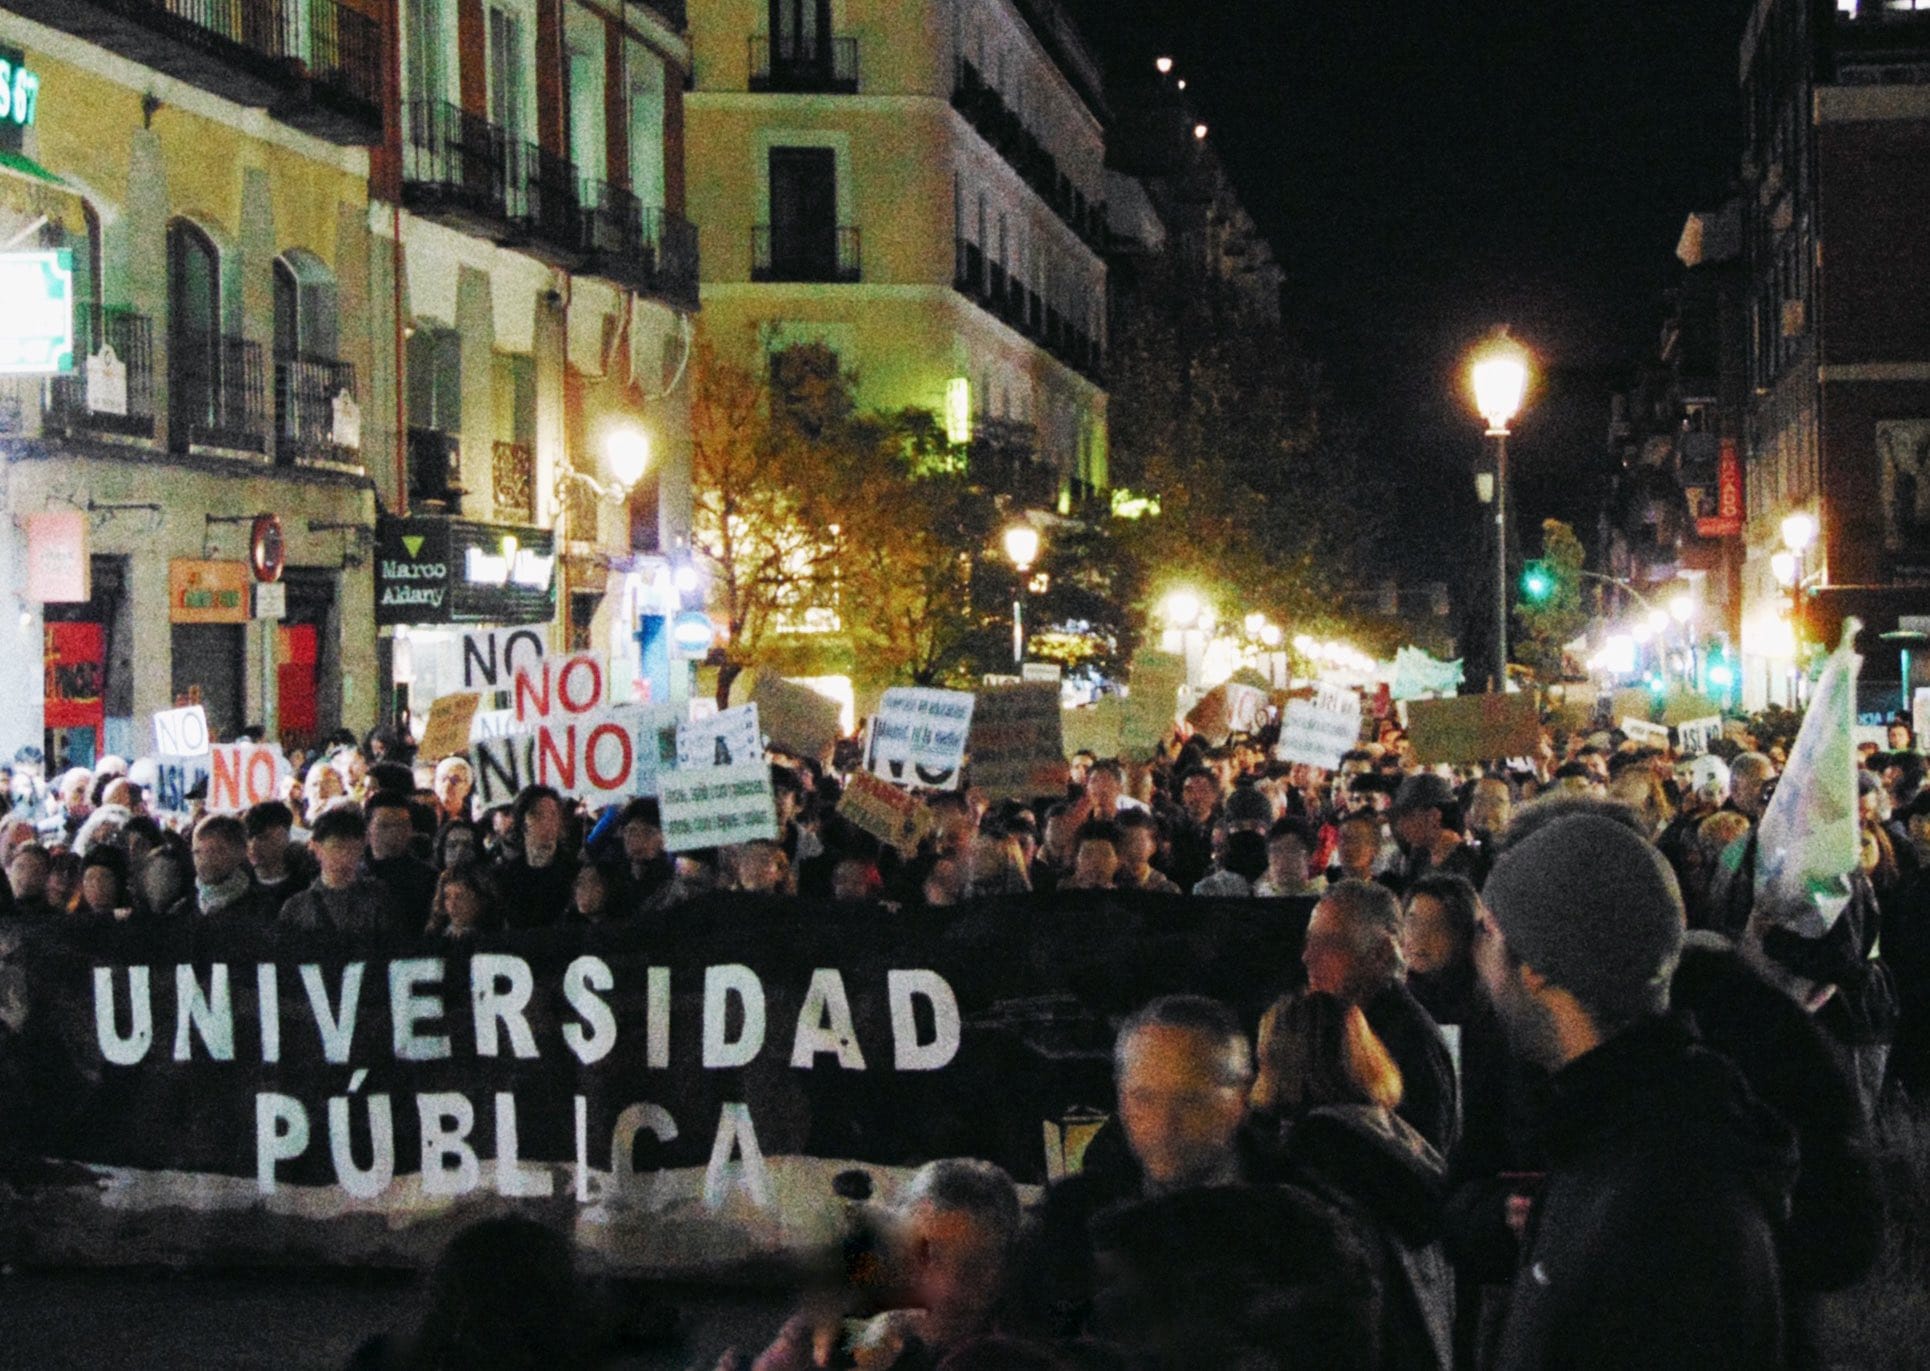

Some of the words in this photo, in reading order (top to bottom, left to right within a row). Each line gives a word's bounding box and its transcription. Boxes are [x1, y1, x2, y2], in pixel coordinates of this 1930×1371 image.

[382, 560, 447, 579] Marco
[382, 585, 446, 608] Aldany
[463, 630, 545, 688] NO
[515, 656, 602, 722] NO
[159, 711, 204, 753] NO
[538, 722, 633, 791] NO
[212, 748, 276, 809] NO
[474, 733, 536, 803] N
[93, 954, 962, 1071] UNIVERSIDAD
[255, 1068, 770, 1209] PÚBLICA
